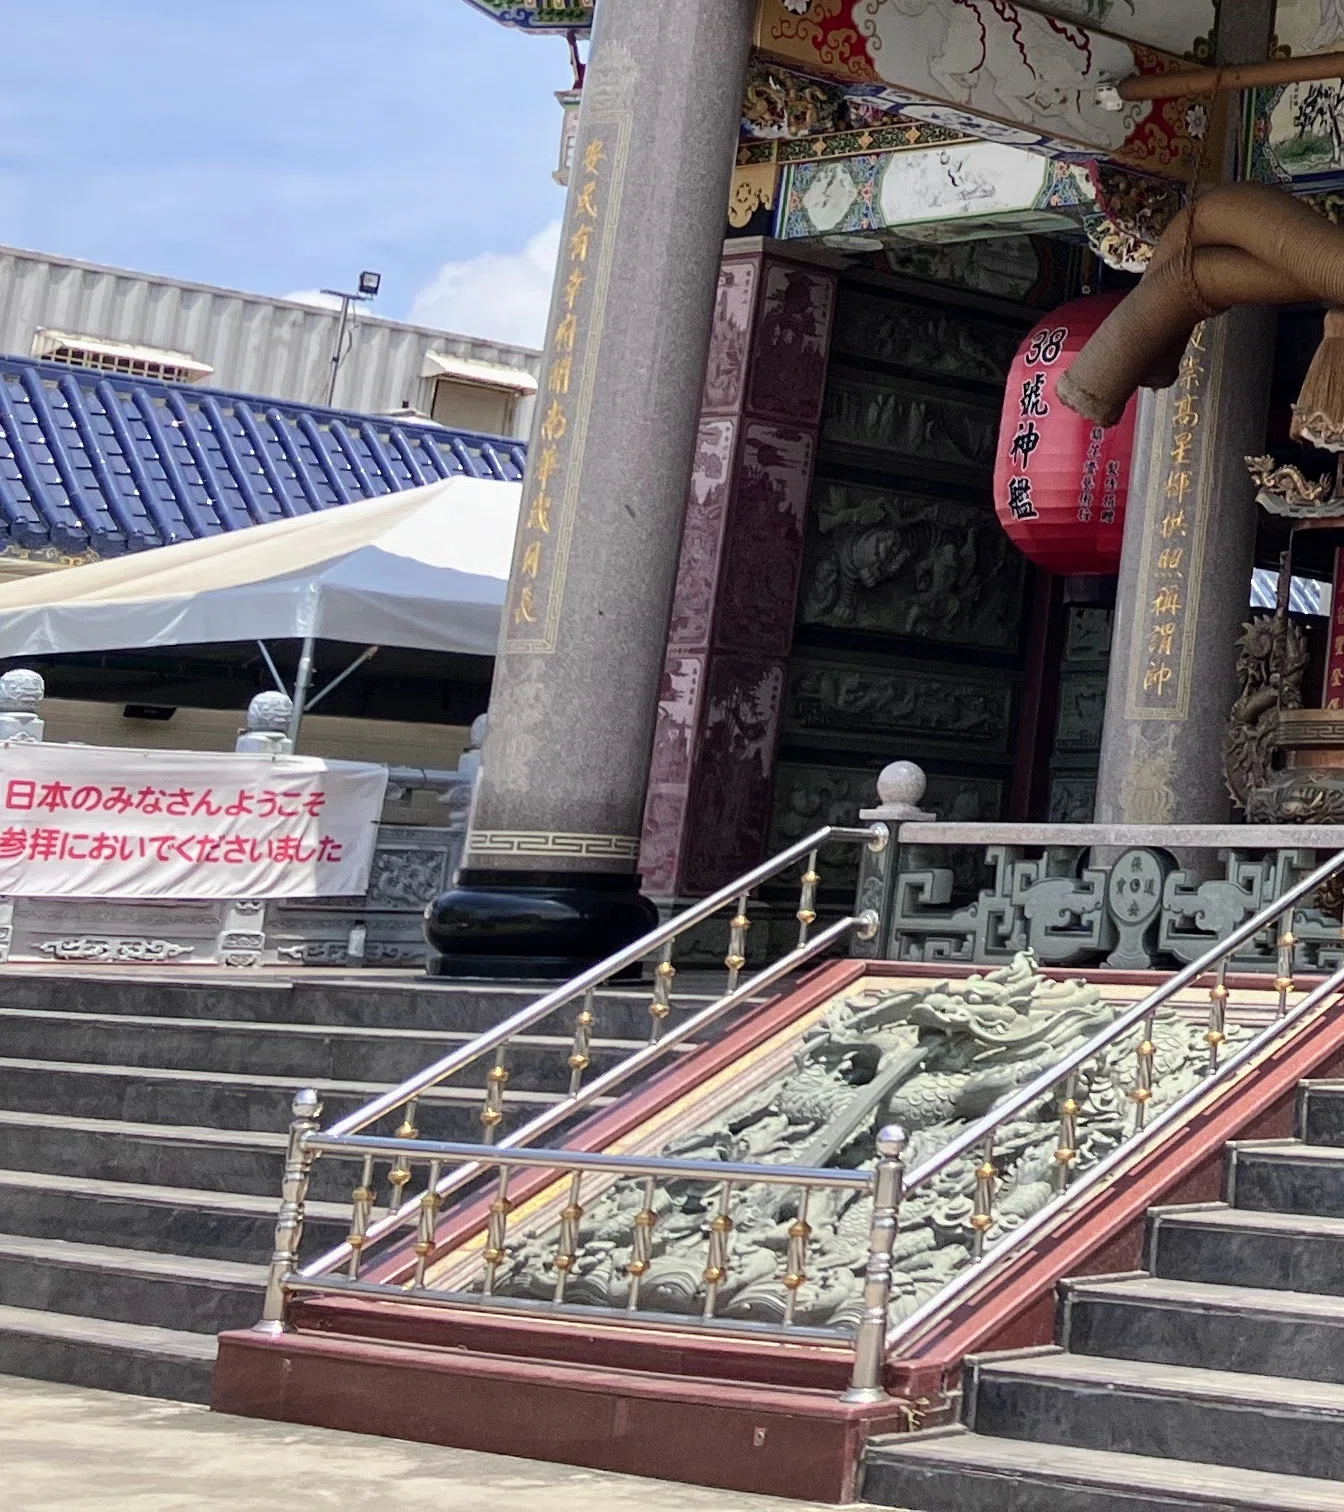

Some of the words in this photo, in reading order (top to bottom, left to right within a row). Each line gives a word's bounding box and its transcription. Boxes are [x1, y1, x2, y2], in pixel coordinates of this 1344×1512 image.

[4, 777, 326, 819] 日本のみなさんようこそ
[0, 825, 342, 864] 参拝においでくださいました
